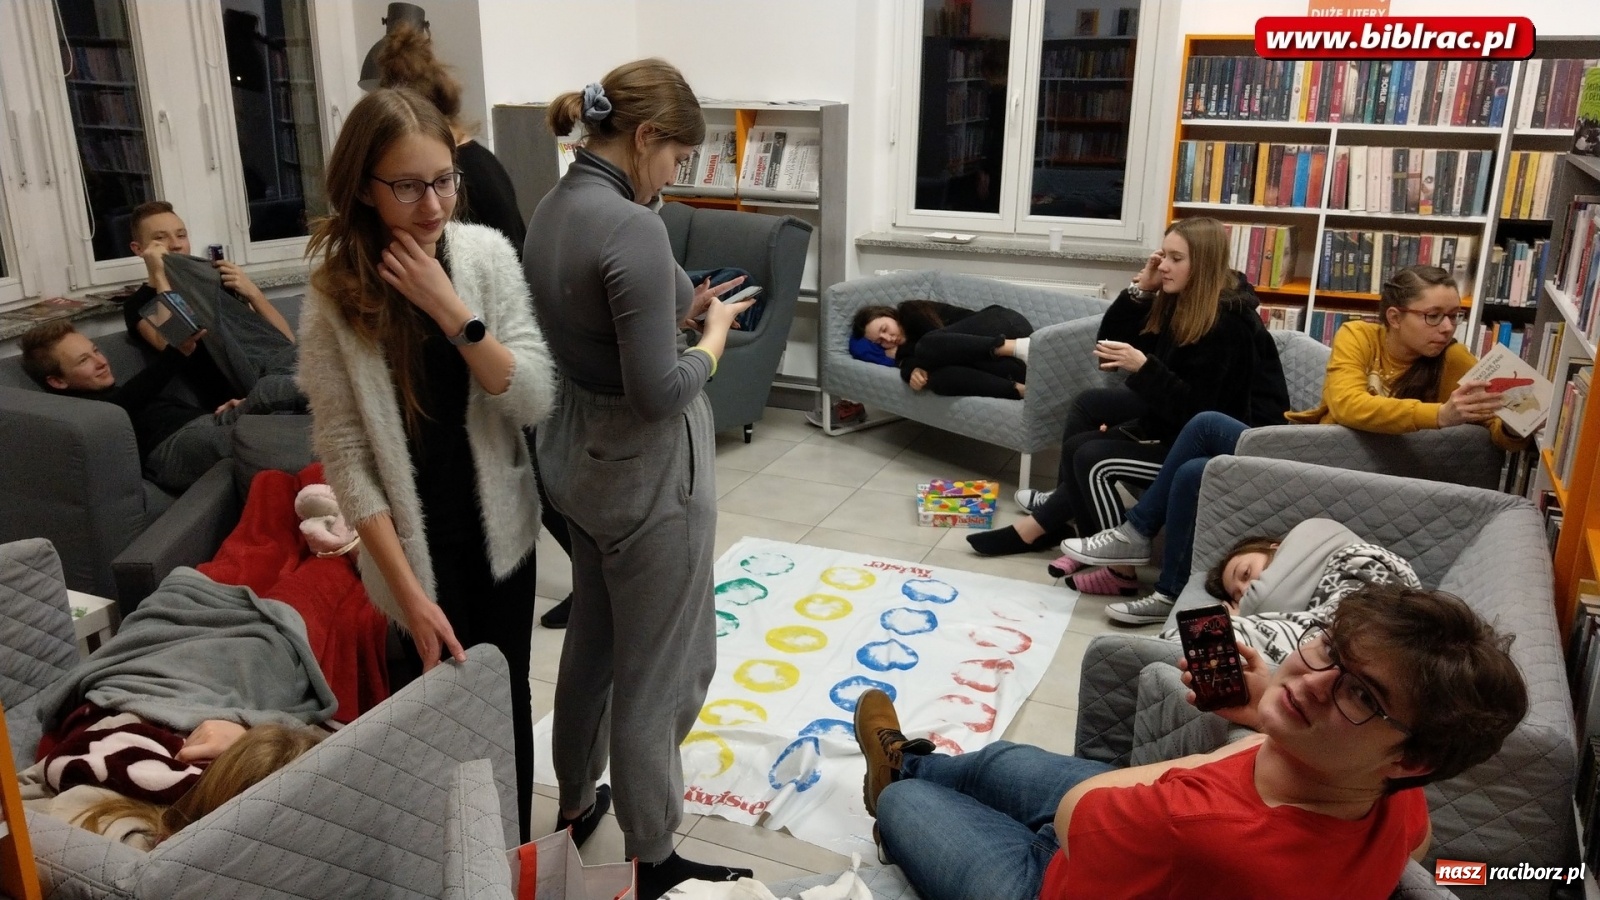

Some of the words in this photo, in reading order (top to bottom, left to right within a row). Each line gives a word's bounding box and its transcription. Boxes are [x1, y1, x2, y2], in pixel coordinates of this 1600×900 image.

[703, 154, 719, 185] Nowiny
[754, 156, 763, 185] DZIENNIK
[863, 561, 934, 579] Twister
[683, 786, 771, 815] Twiste
